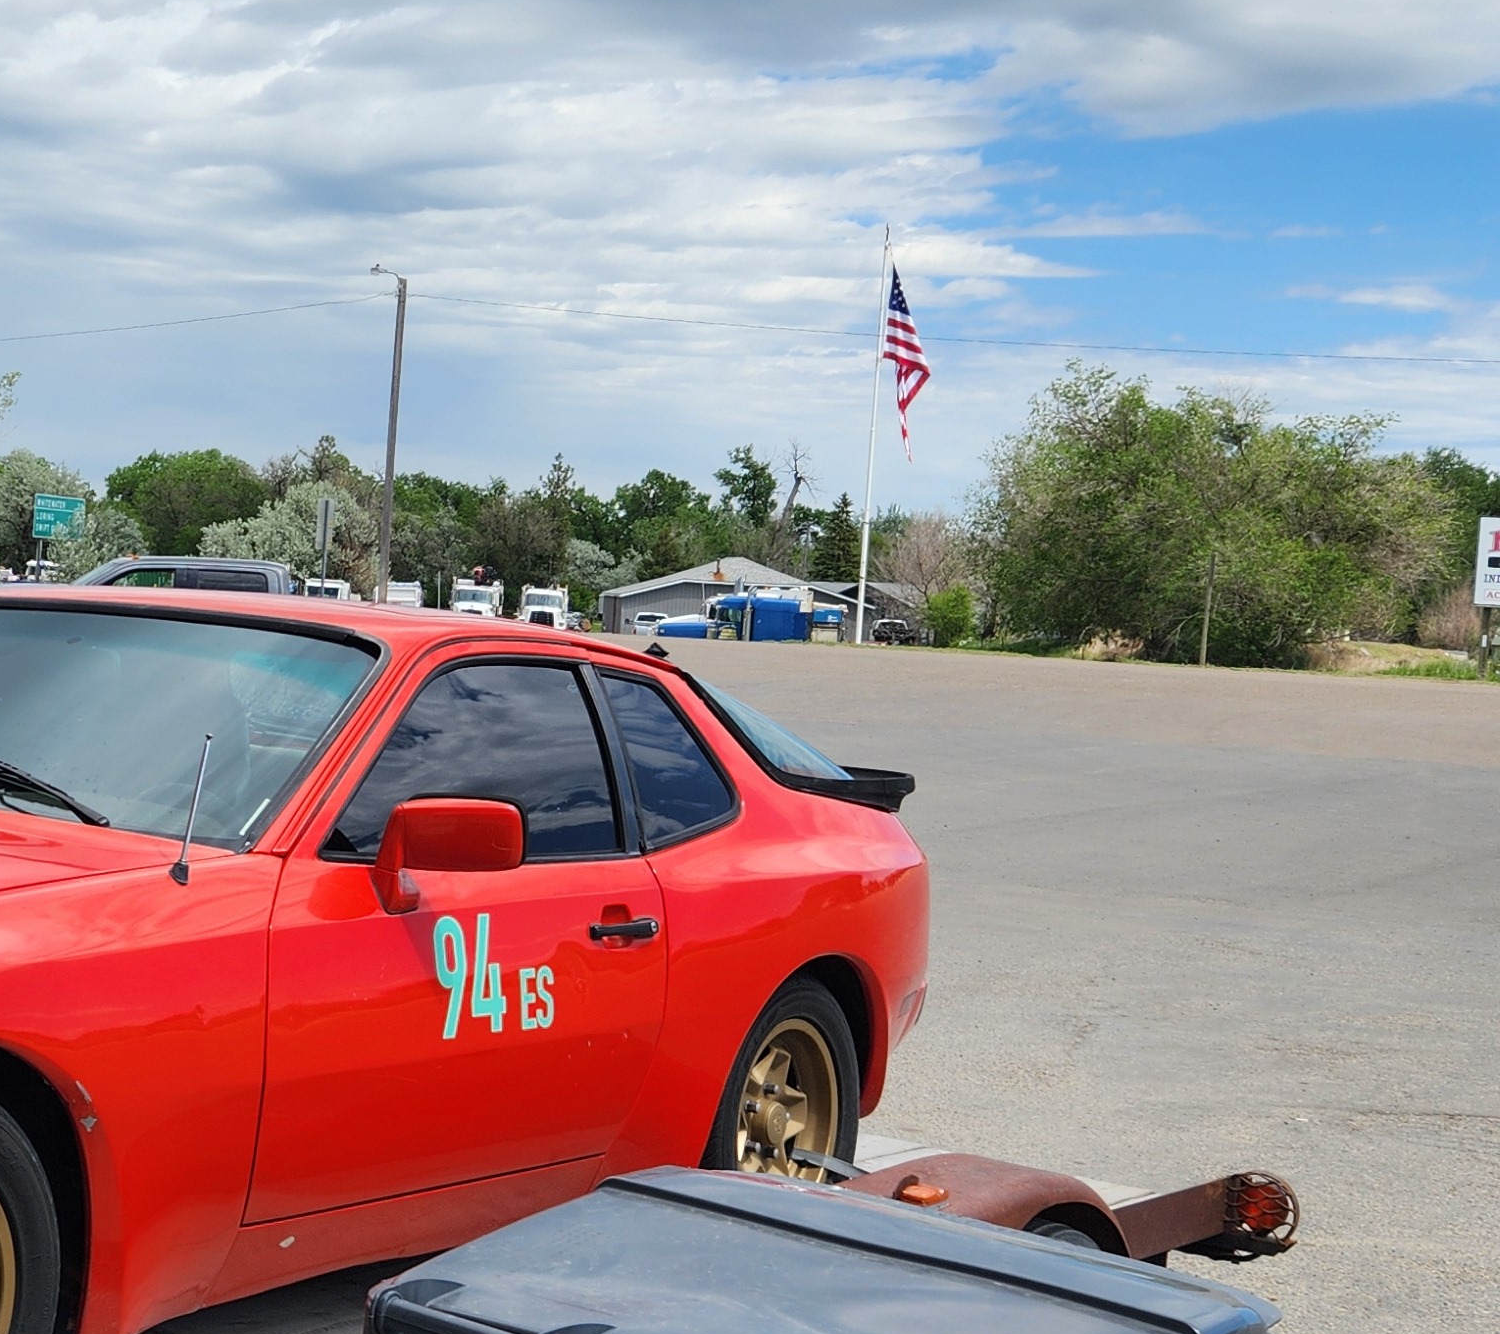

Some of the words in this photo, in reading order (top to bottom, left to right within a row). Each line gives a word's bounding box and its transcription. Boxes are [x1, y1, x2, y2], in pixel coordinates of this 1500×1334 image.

[36, 512, 54, 521] LORING
[433, 913, 506, 1040] 94
[519, 965, 555, 1030] ES
